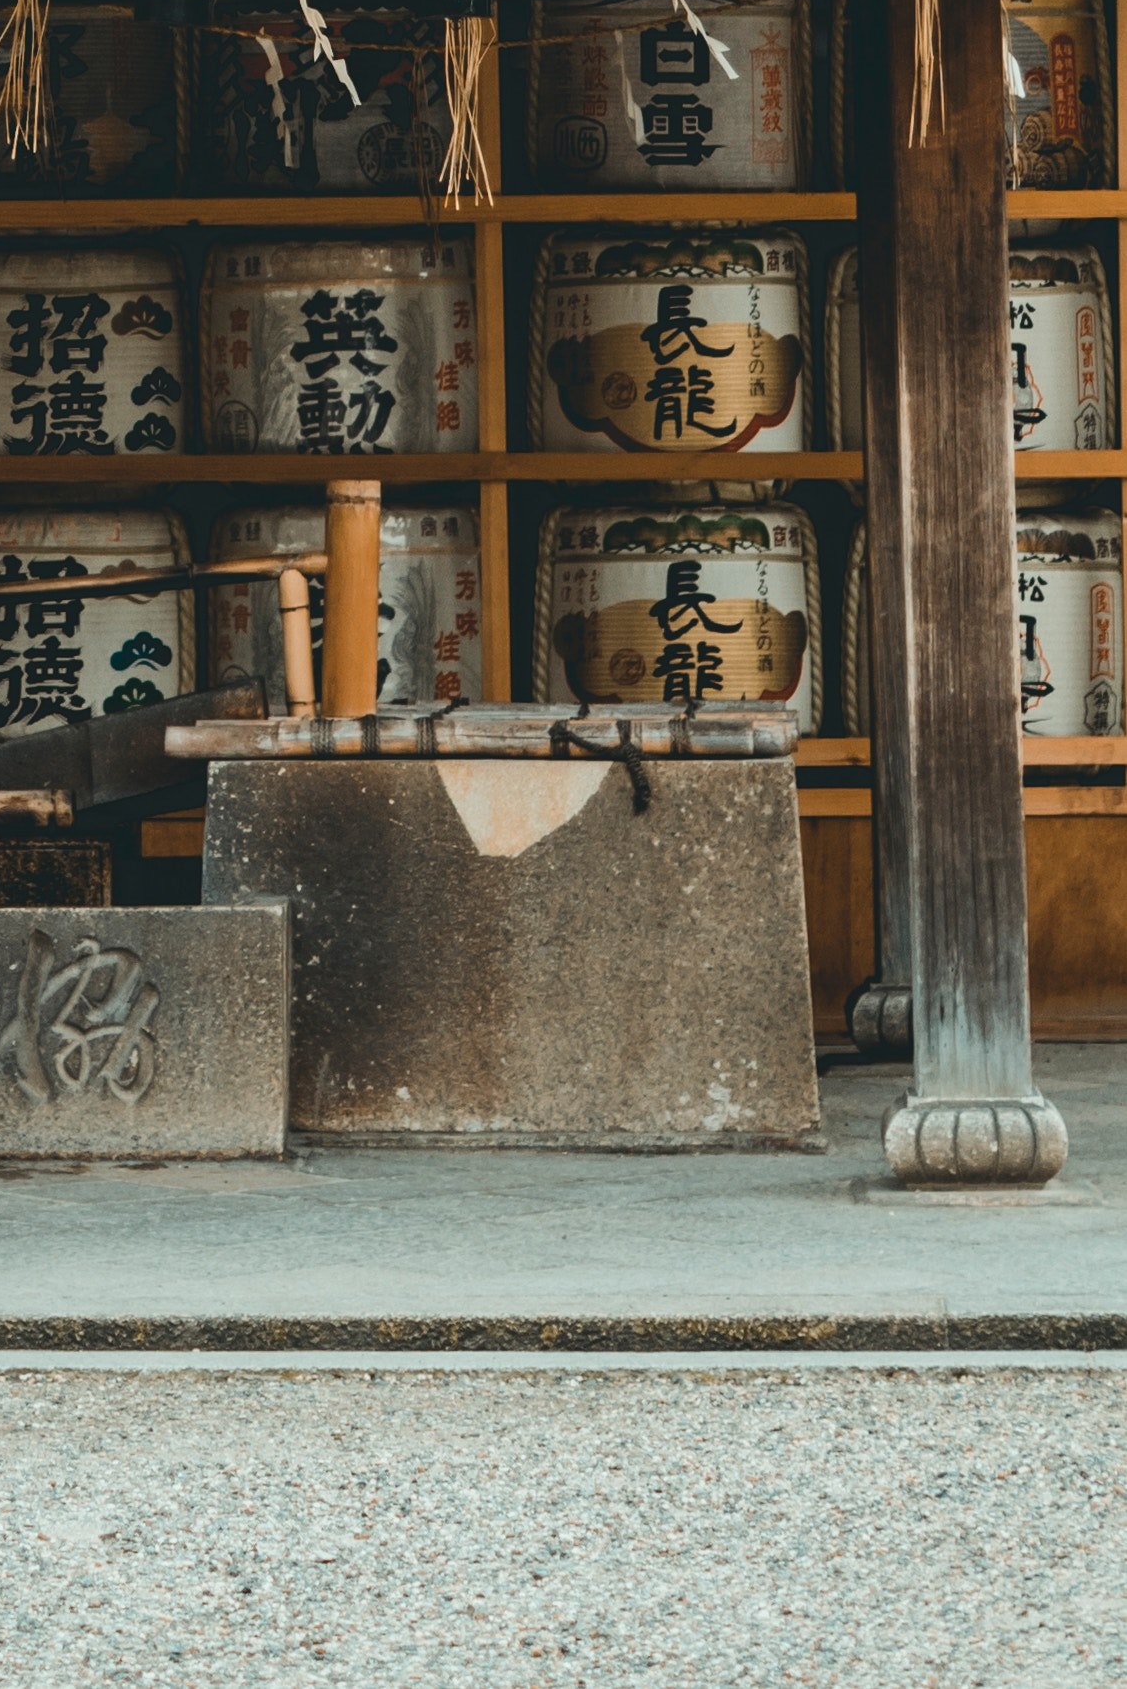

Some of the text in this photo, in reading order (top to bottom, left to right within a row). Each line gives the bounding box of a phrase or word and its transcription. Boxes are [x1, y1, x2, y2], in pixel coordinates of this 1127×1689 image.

[636, 21, 727, 166] 白雪
[640, 284, 737, 440] 長龍
[1018, 573, 1048, 602] 松
